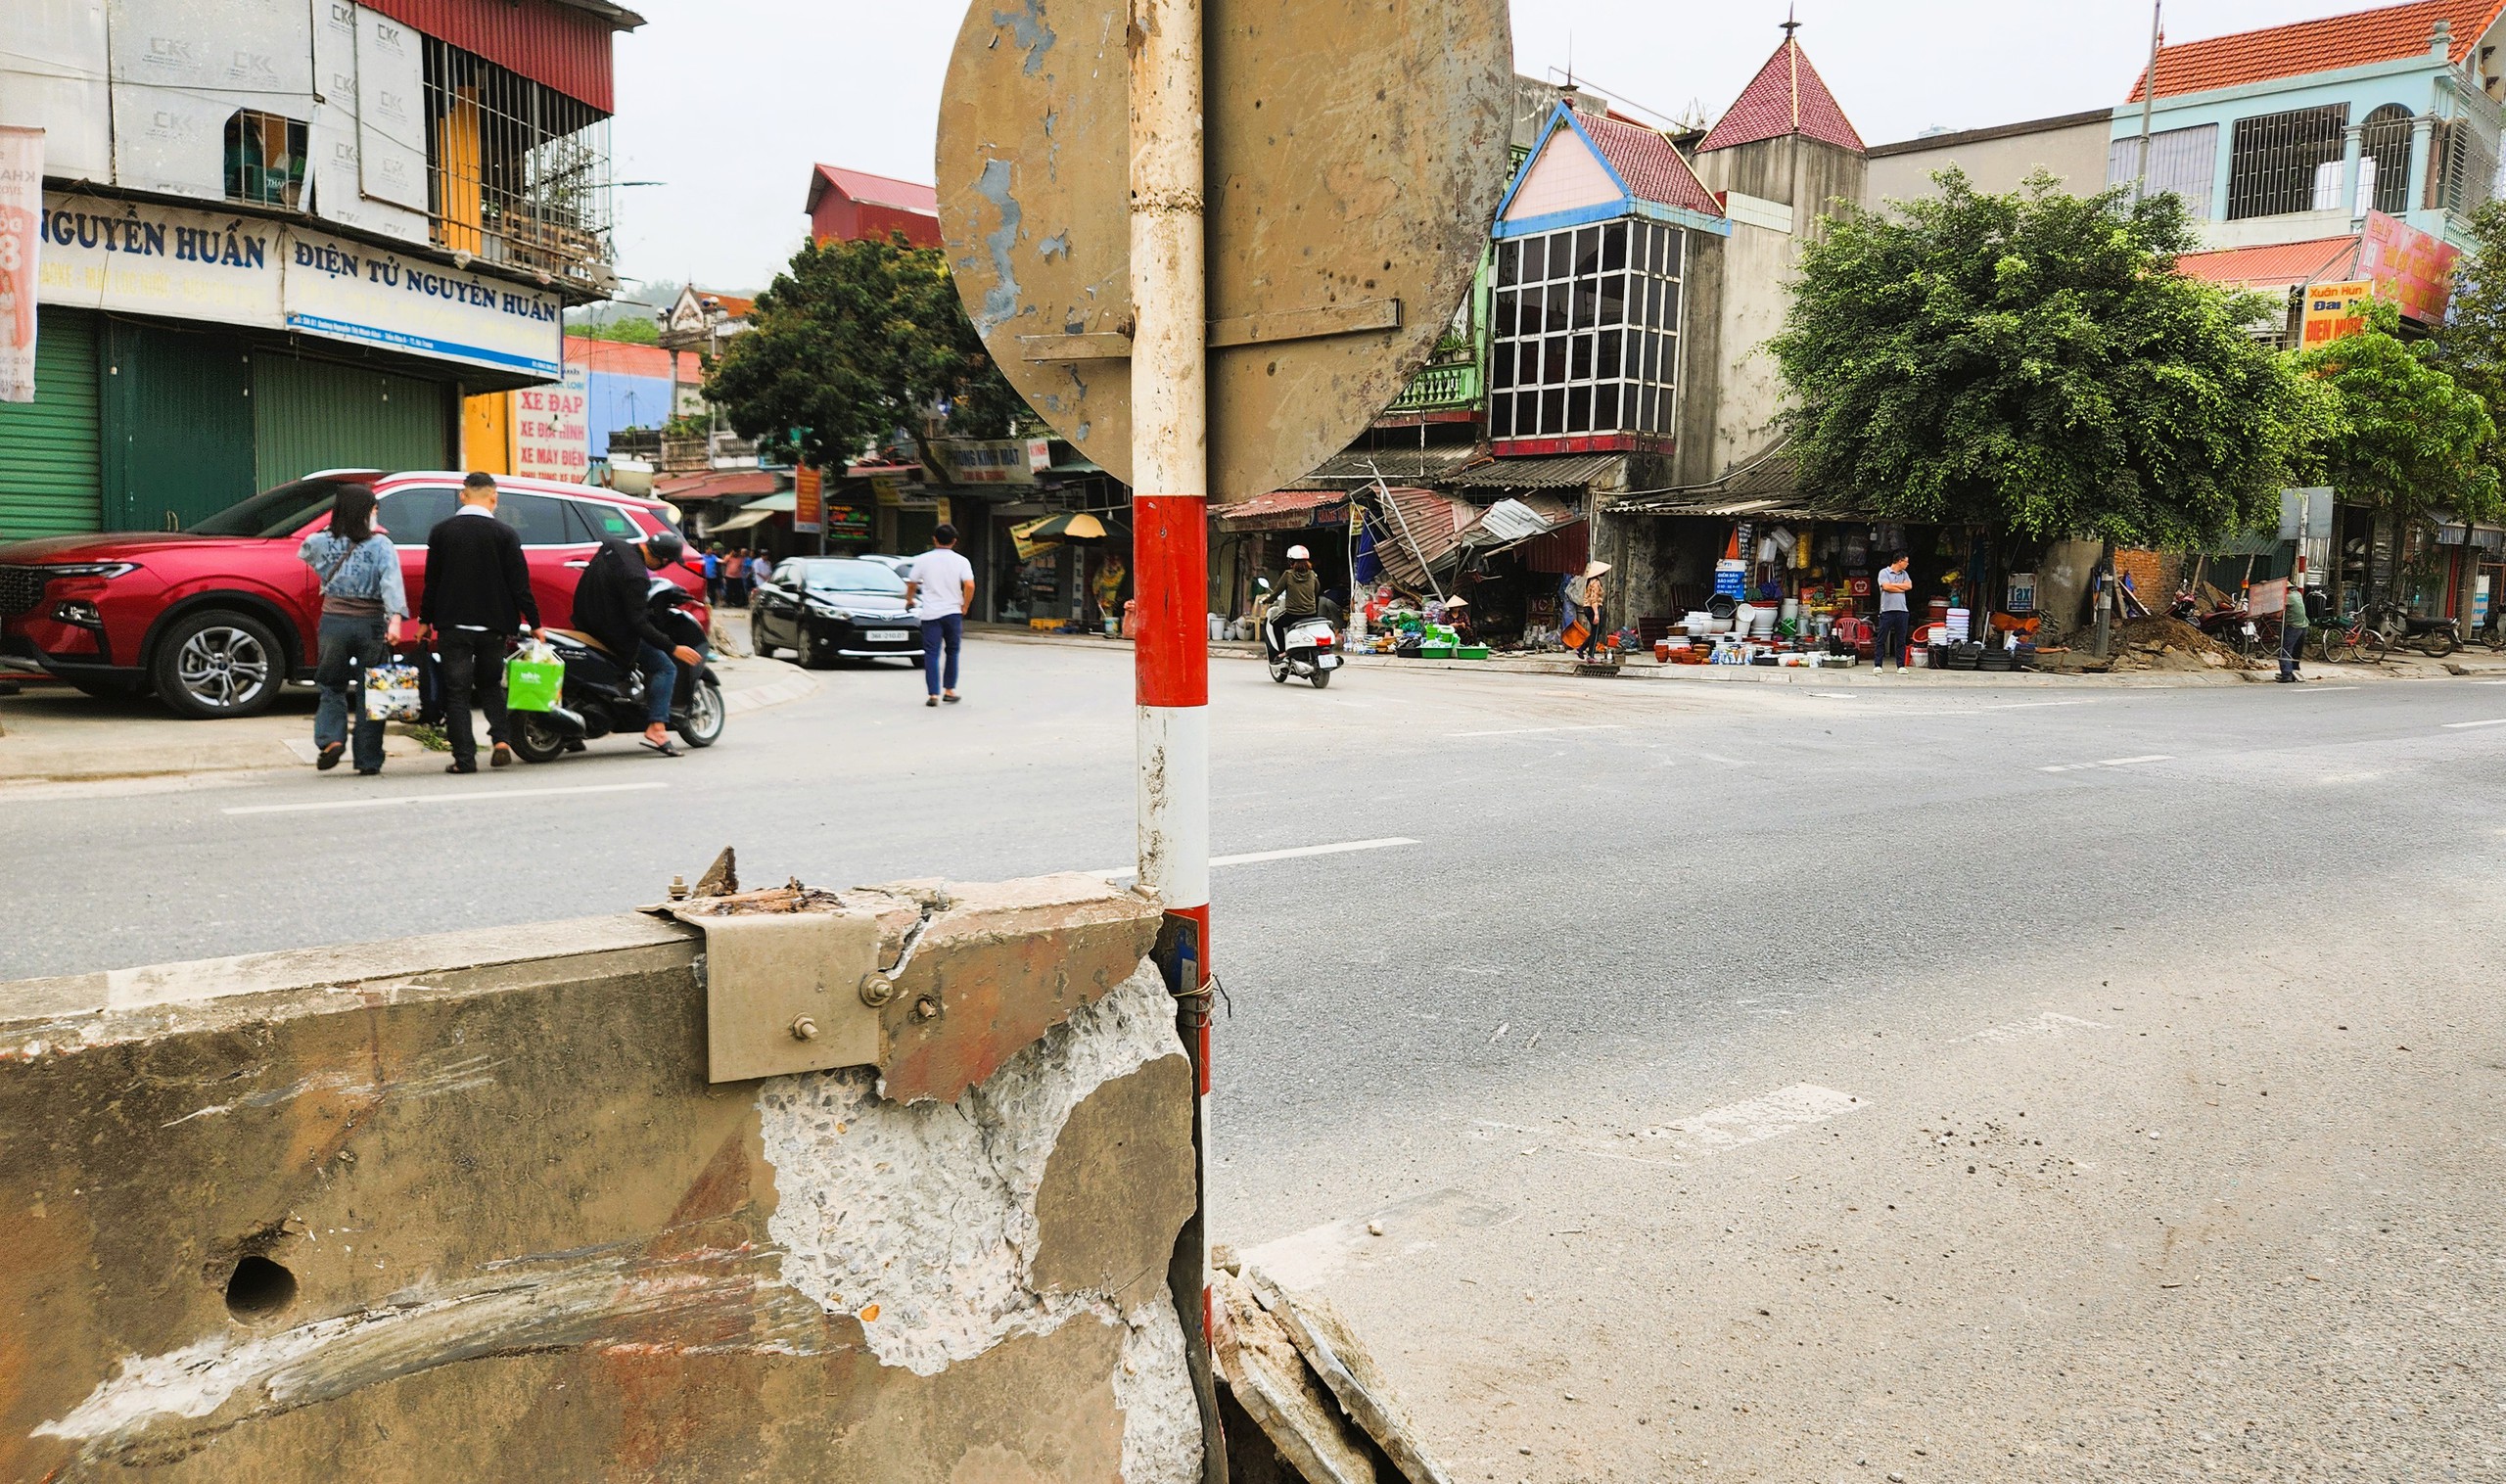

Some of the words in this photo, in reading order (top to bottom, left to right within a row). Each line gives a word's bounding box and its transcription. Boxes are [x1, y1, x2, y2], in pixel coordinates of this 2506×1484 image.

[175, 218, 266, 269] HUẤN
[295, 241, 358, 279] ĐIỆN
[366, 255, 400, 286] TỬ
[405, 268, 496, 309] NGUYỄN
[502, 293, 556, 322] HUẤN
[2310, 288, 2339, 299] Xuân
[2305, 319, 2332, 344] ĐIỆN
[521, 392, 543, 411] XE
[548, 394, 583, 417] ĐẠP
[521, 421, 534, 438] XE
[521, 447, 534, 464] XE
[536, 445, 559, 465] MÁY
[562, 447, 584, 470] ĐIỆN
